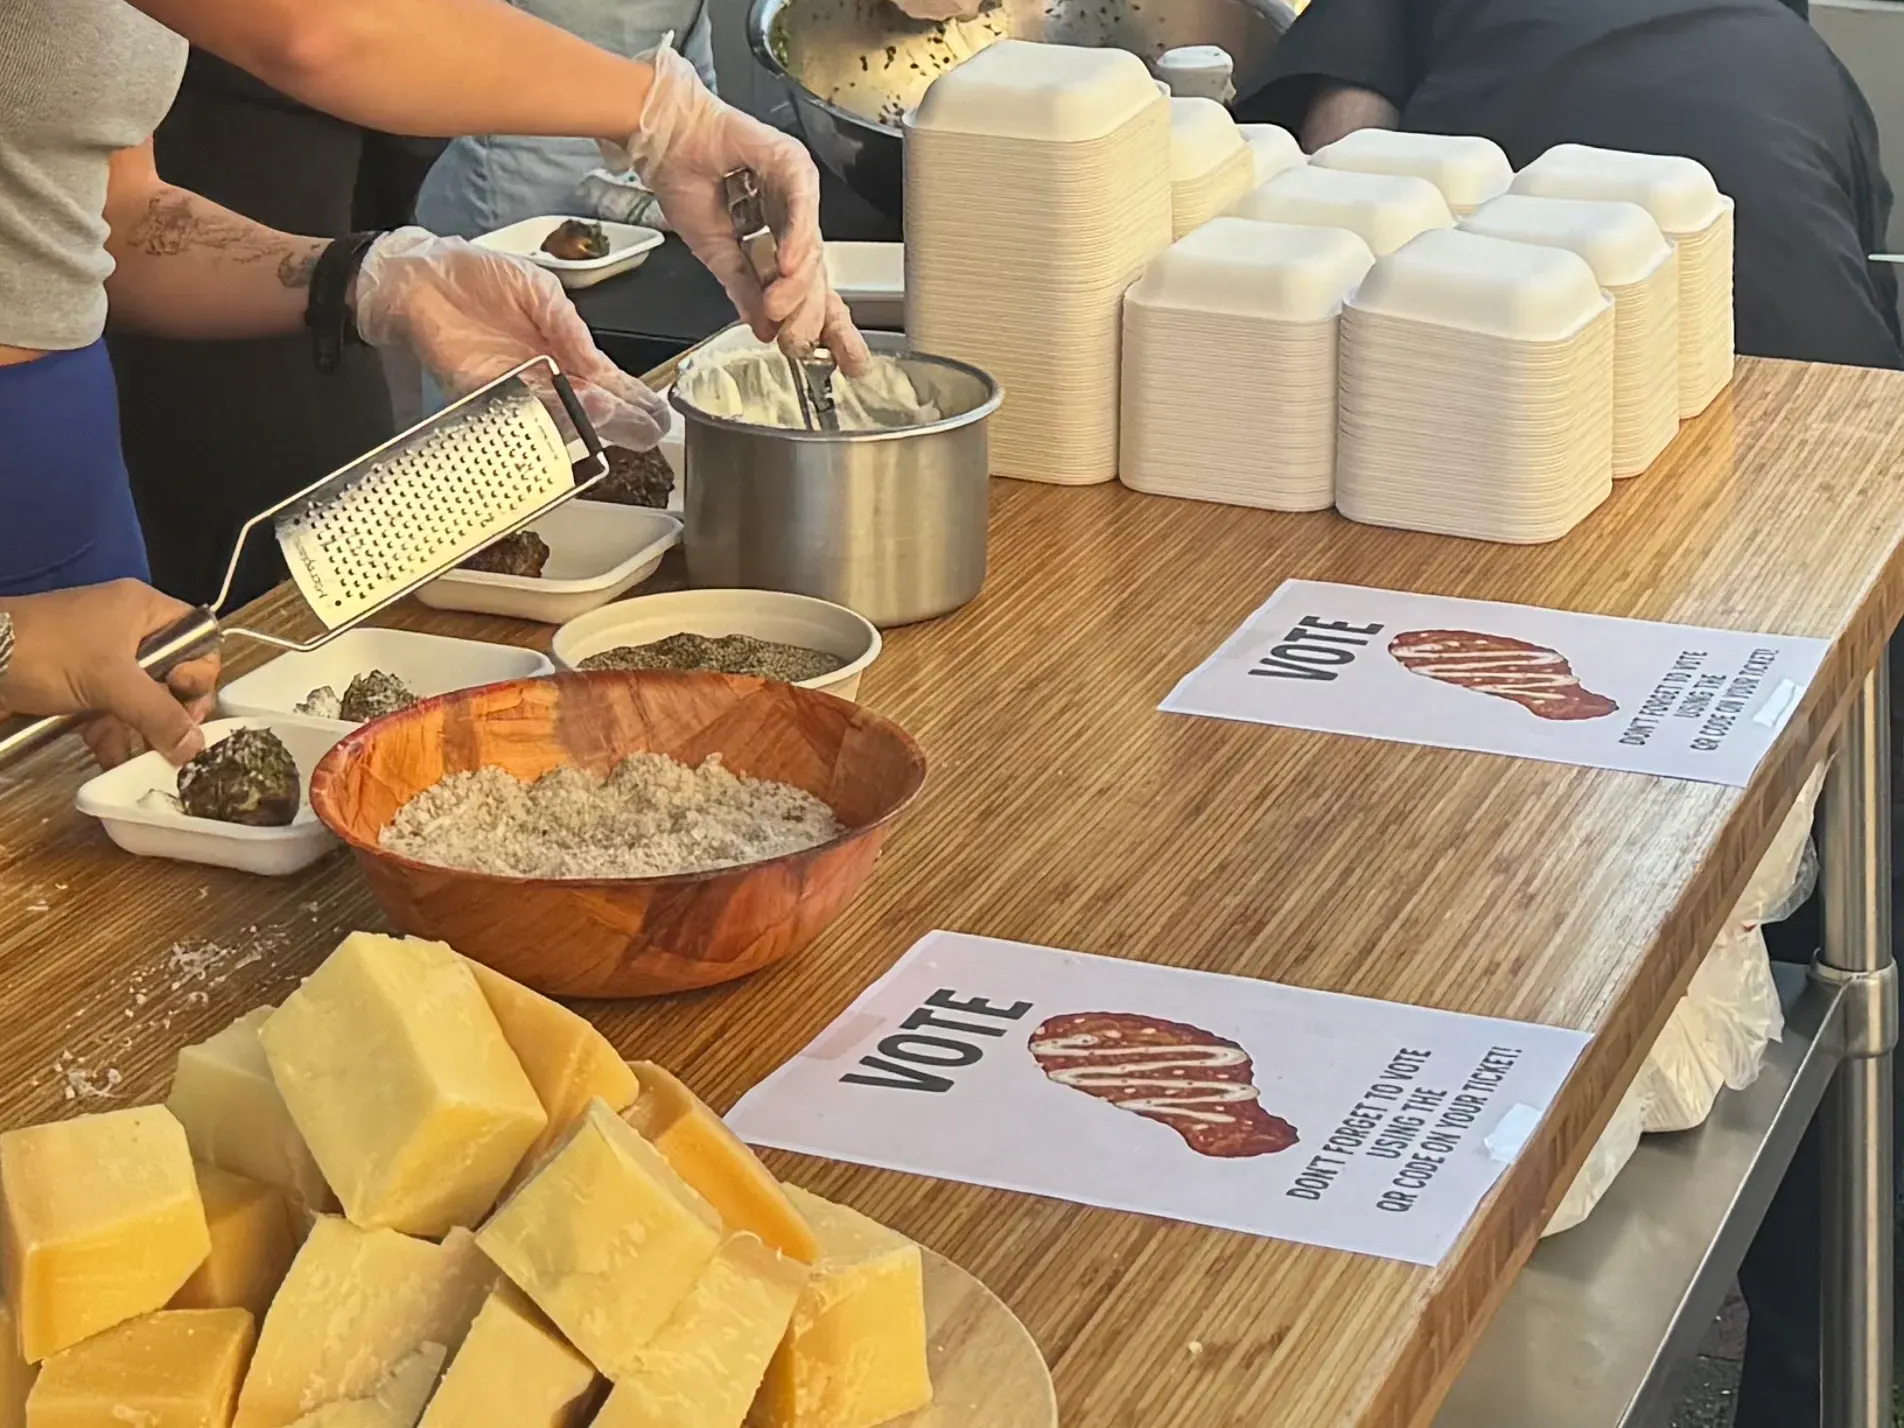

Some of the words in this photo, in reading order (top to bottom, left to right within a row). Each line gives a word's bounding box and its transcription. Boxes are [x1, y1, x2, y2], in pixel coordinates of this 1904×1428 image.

[1247, 615, 1385, 681] VOTE
[1671, 650, 1709, 671] VOTE
[1662, 672, 1692, 684] TO
[1693, 672, 1728, 690] THE
[1722, 677, 1760, 700] YOUR
[1639, 684, 1684, 718] FORGET
[1672, 691, 1715, 719] USING
[1714, 699, 1746, 714] ON
[1618, 716, 1661, 746] DON'T
[1699, 713, 1737, 736] CODE
[1689, 737, 1724, 751] QR
[838, 987, 1035, 1094] VOTE
[1378, 1047, 1433, 1081] VOTE
[1461, 1045, 1523, 1093] TICKET!
[1363, 1082, 1405, 1101] TO
[1365, 1115, 1426, 1160] USING
[1400, 1087, 1449, 1113] THE
[1435, 1094, 1489, 1129] YOUR
[1321, 1101, 1389, 1156] FORGET
[1419, 1130, 1462, 1154] ON
[1285, 1154, 1347, 1201] DON'T
[1392, 1152, 1446, 1189] CODE
[1375, 1190, 1419, 1213] QR
